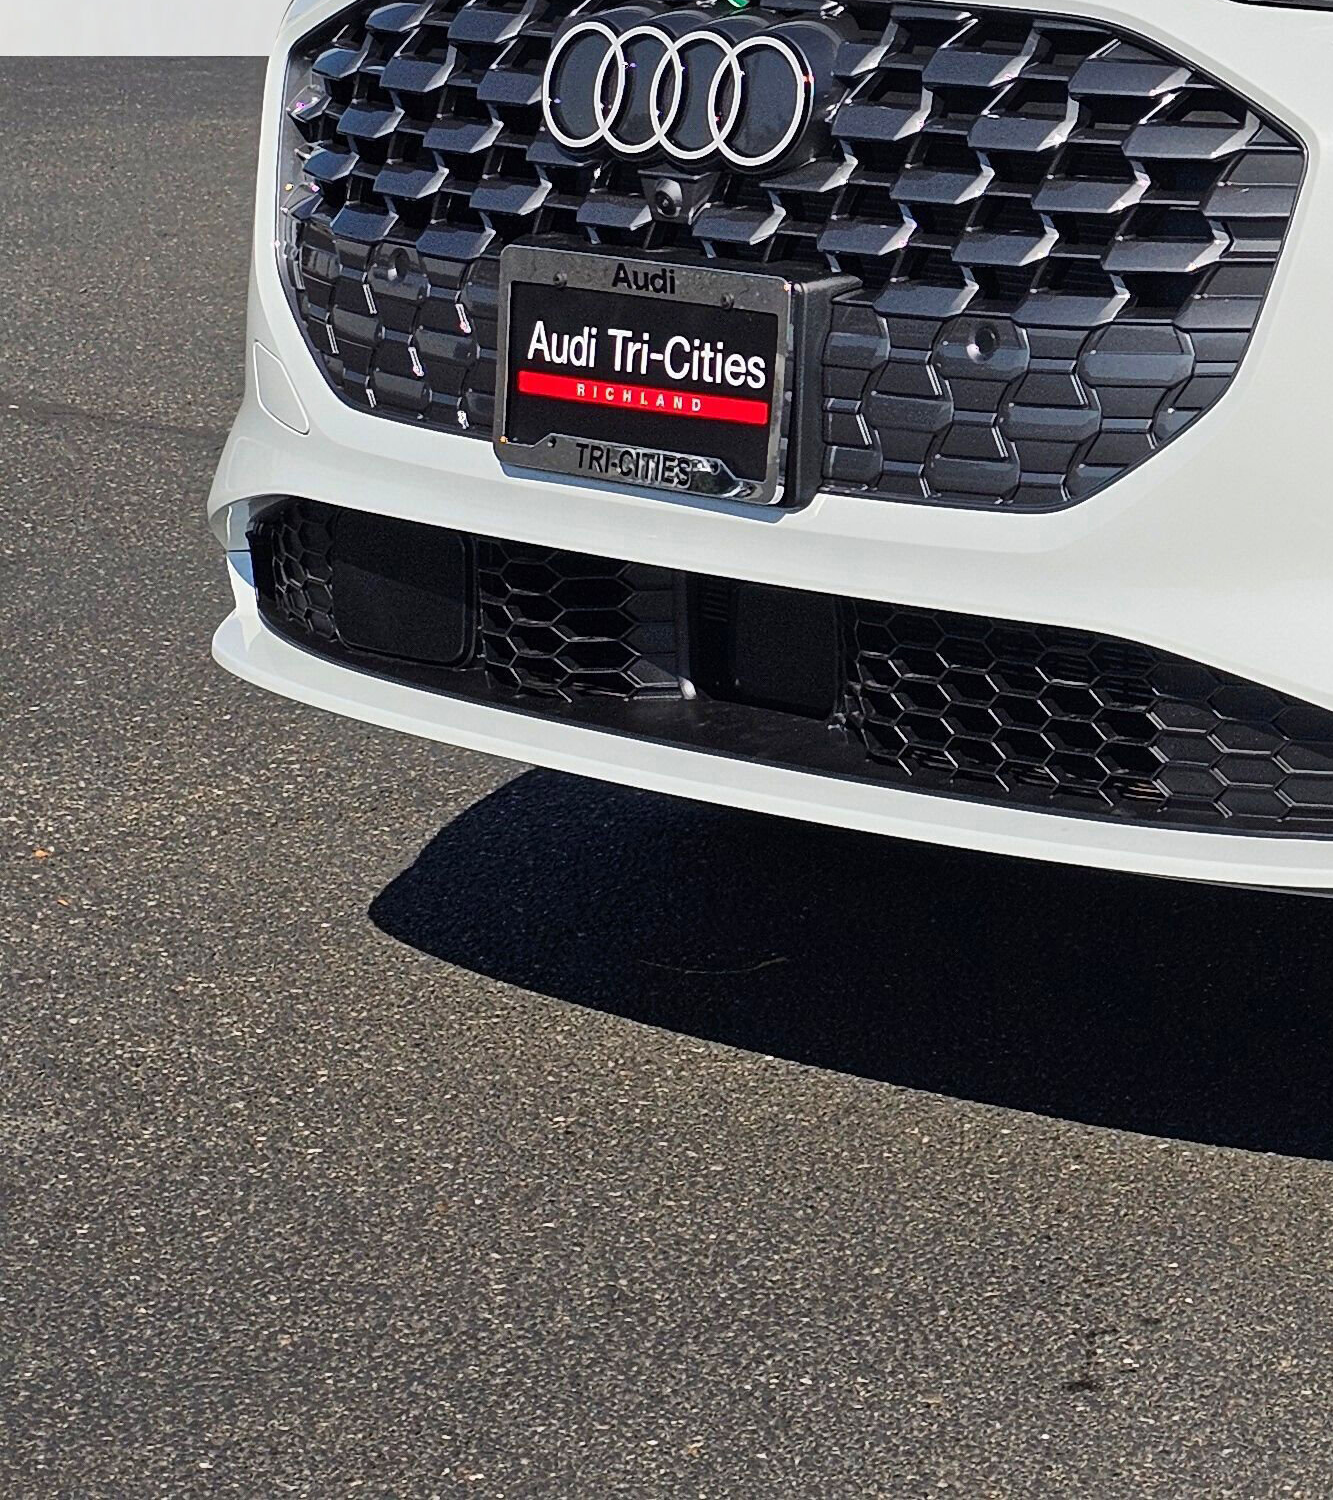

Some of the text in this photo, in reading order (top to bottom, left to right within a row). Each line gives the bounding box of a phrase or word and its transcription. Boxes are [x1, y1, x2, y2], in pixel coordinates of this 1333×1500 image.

[611, 263, 677, 295] Audi
[527, 320, 767, 390] Audi Tri-Cities
[577, 383, 703, 412] RICHLAND
[576, 442, 693, 488] TRI-CITIES
